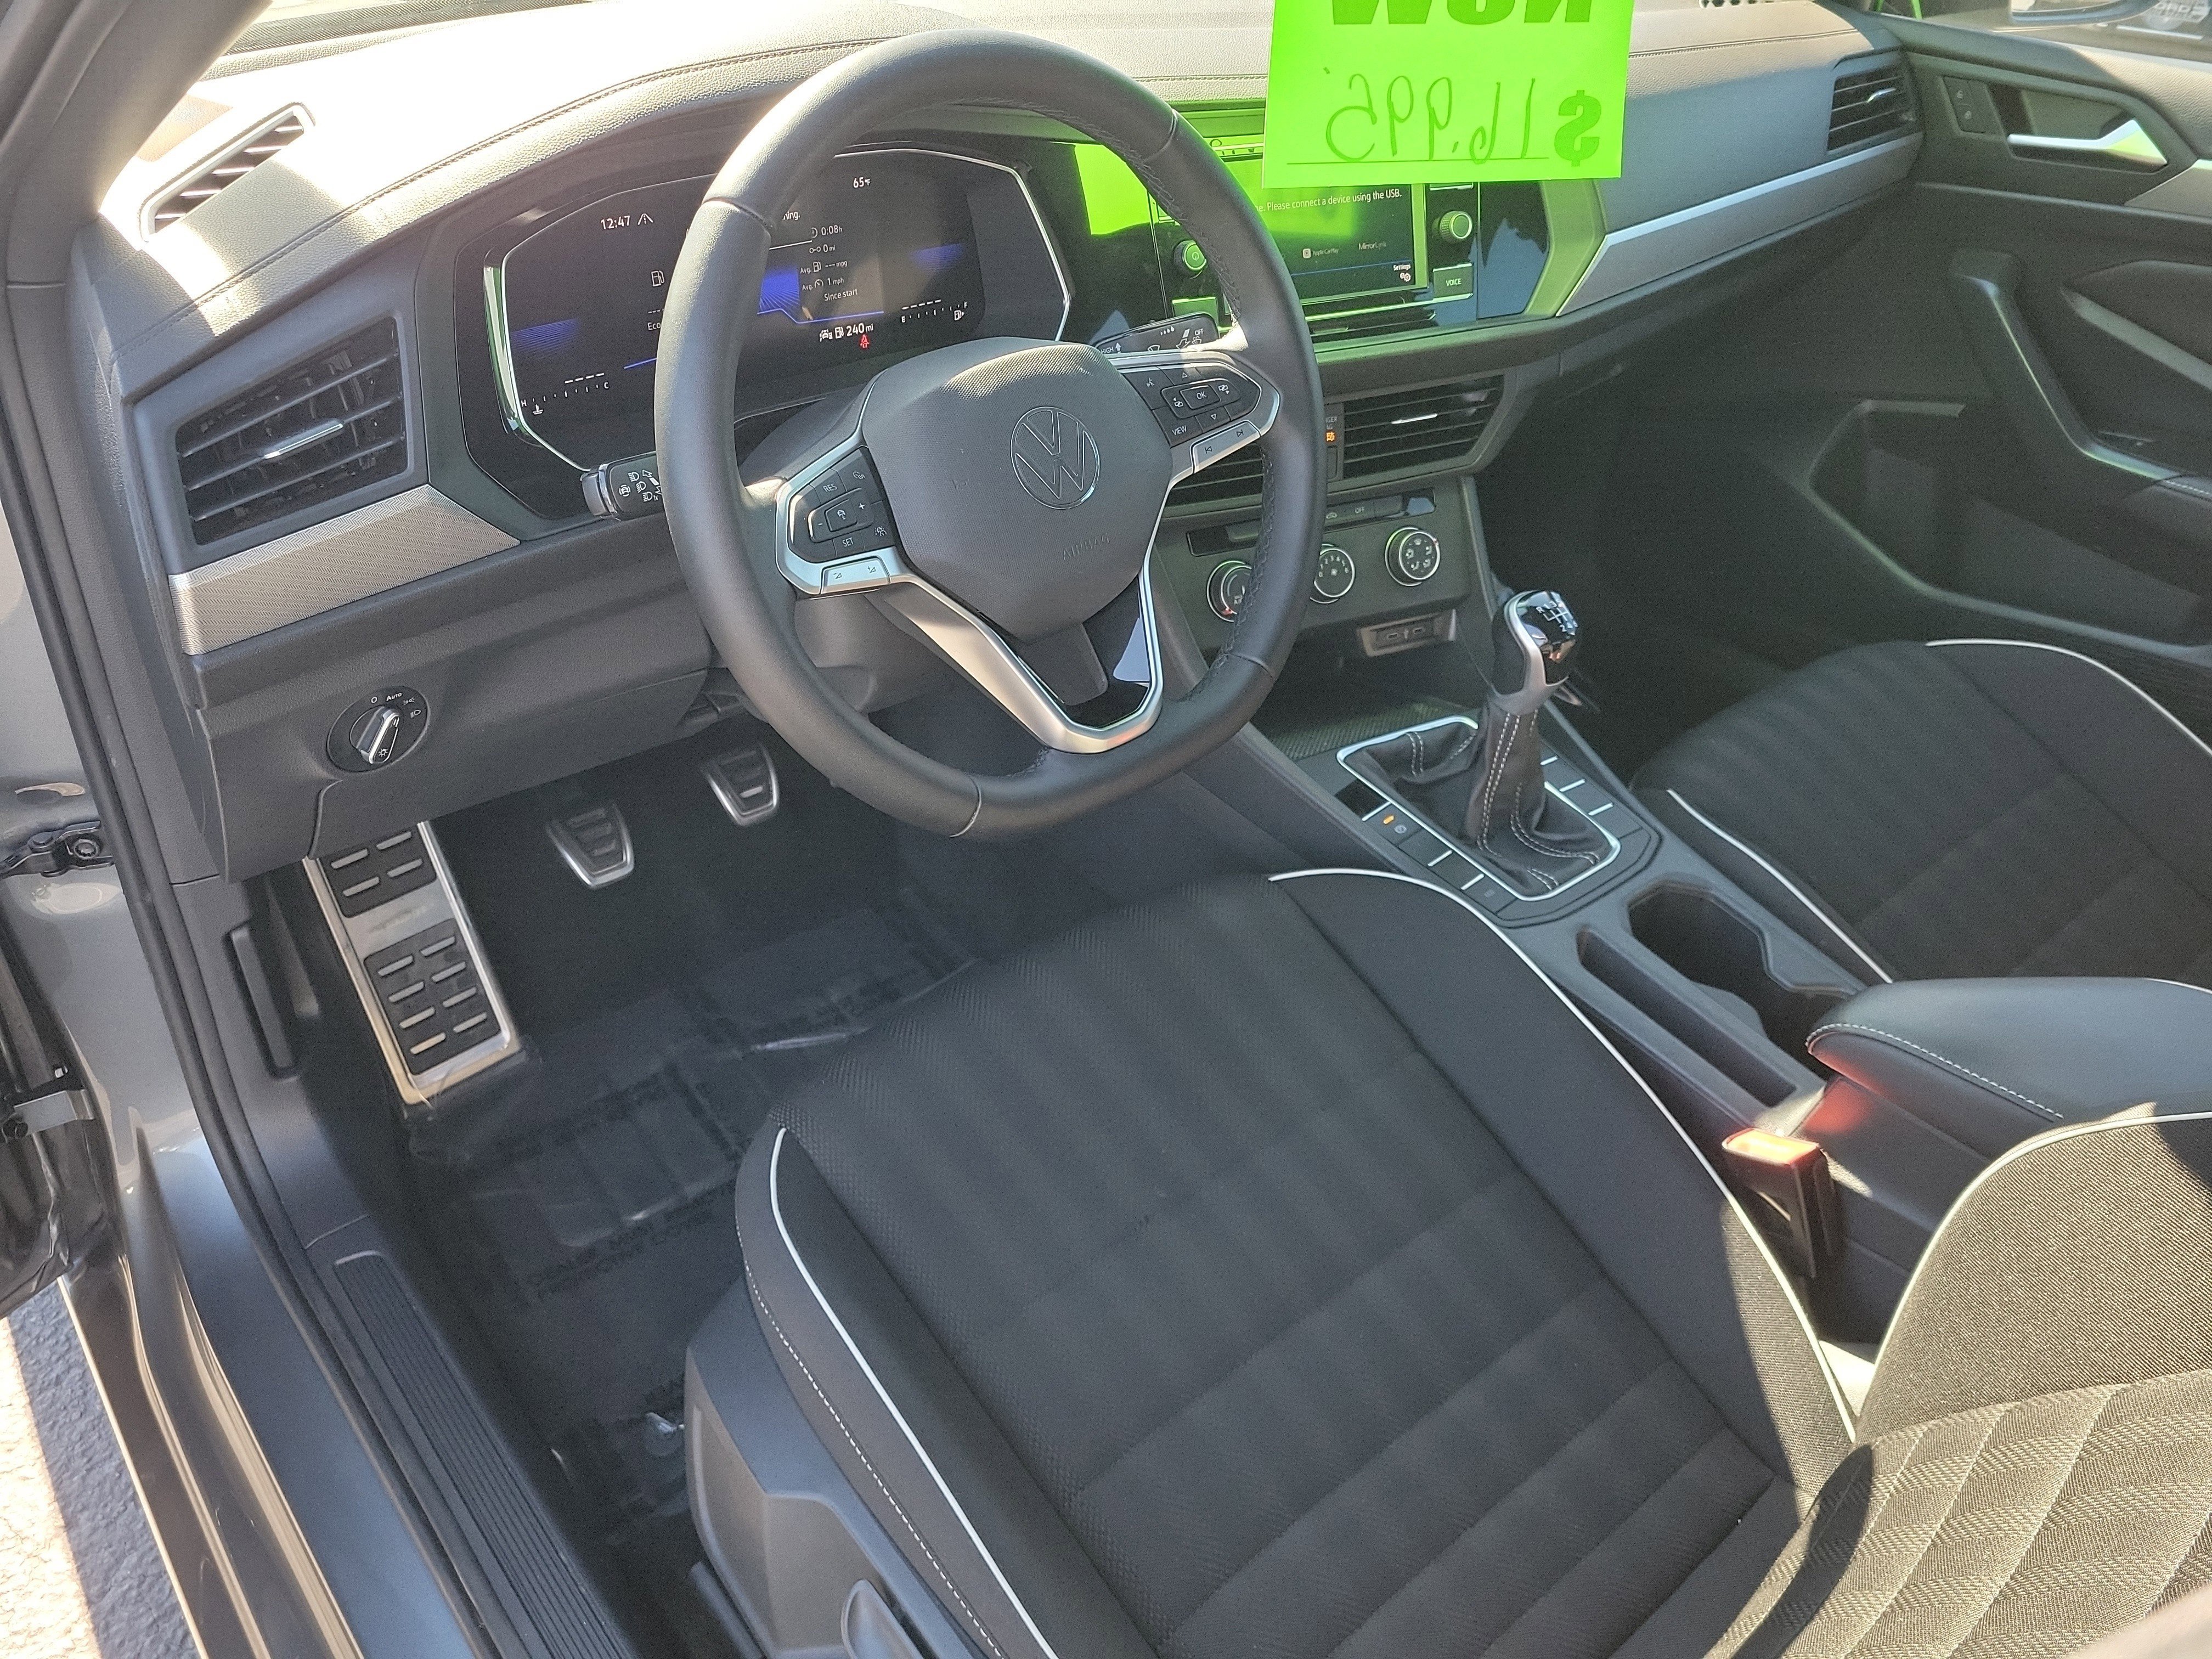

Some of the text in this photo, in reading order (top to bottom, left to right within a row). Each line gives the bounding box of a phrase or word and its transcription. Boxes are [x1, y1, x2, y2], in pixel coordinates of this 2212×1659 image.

[1267, 201, 1290, 211] Please
[1291, 198, 1321, 208] connect
[1328, 195, 1351, 205] device
[1352, 192, 1371, 202] using
[1373, 190, 1385, 200] the
[1385, 188, 1402, 199] USB.
[600, 215, 630, 230] 12:47
[1393, 263, 1411, 272] Settings
[1446, 278, 1462, 286] VOICE
[824, 288, 858, 301] Since start
[846, 323, 865, 336] 240
[1194, 328, 1204, 336] OFF
[1101, 346, 1114, 354] HIGH
[1196, 391, 1206, 400] OK
[1172, 425, 1187, 436] VIEW
[822, 483, 837, 493] RES
[1355, 506, 1365, 514] OFF
[842, 537, 854, 548] SET
[1063, 533, 1110, 560] AIRBAG
